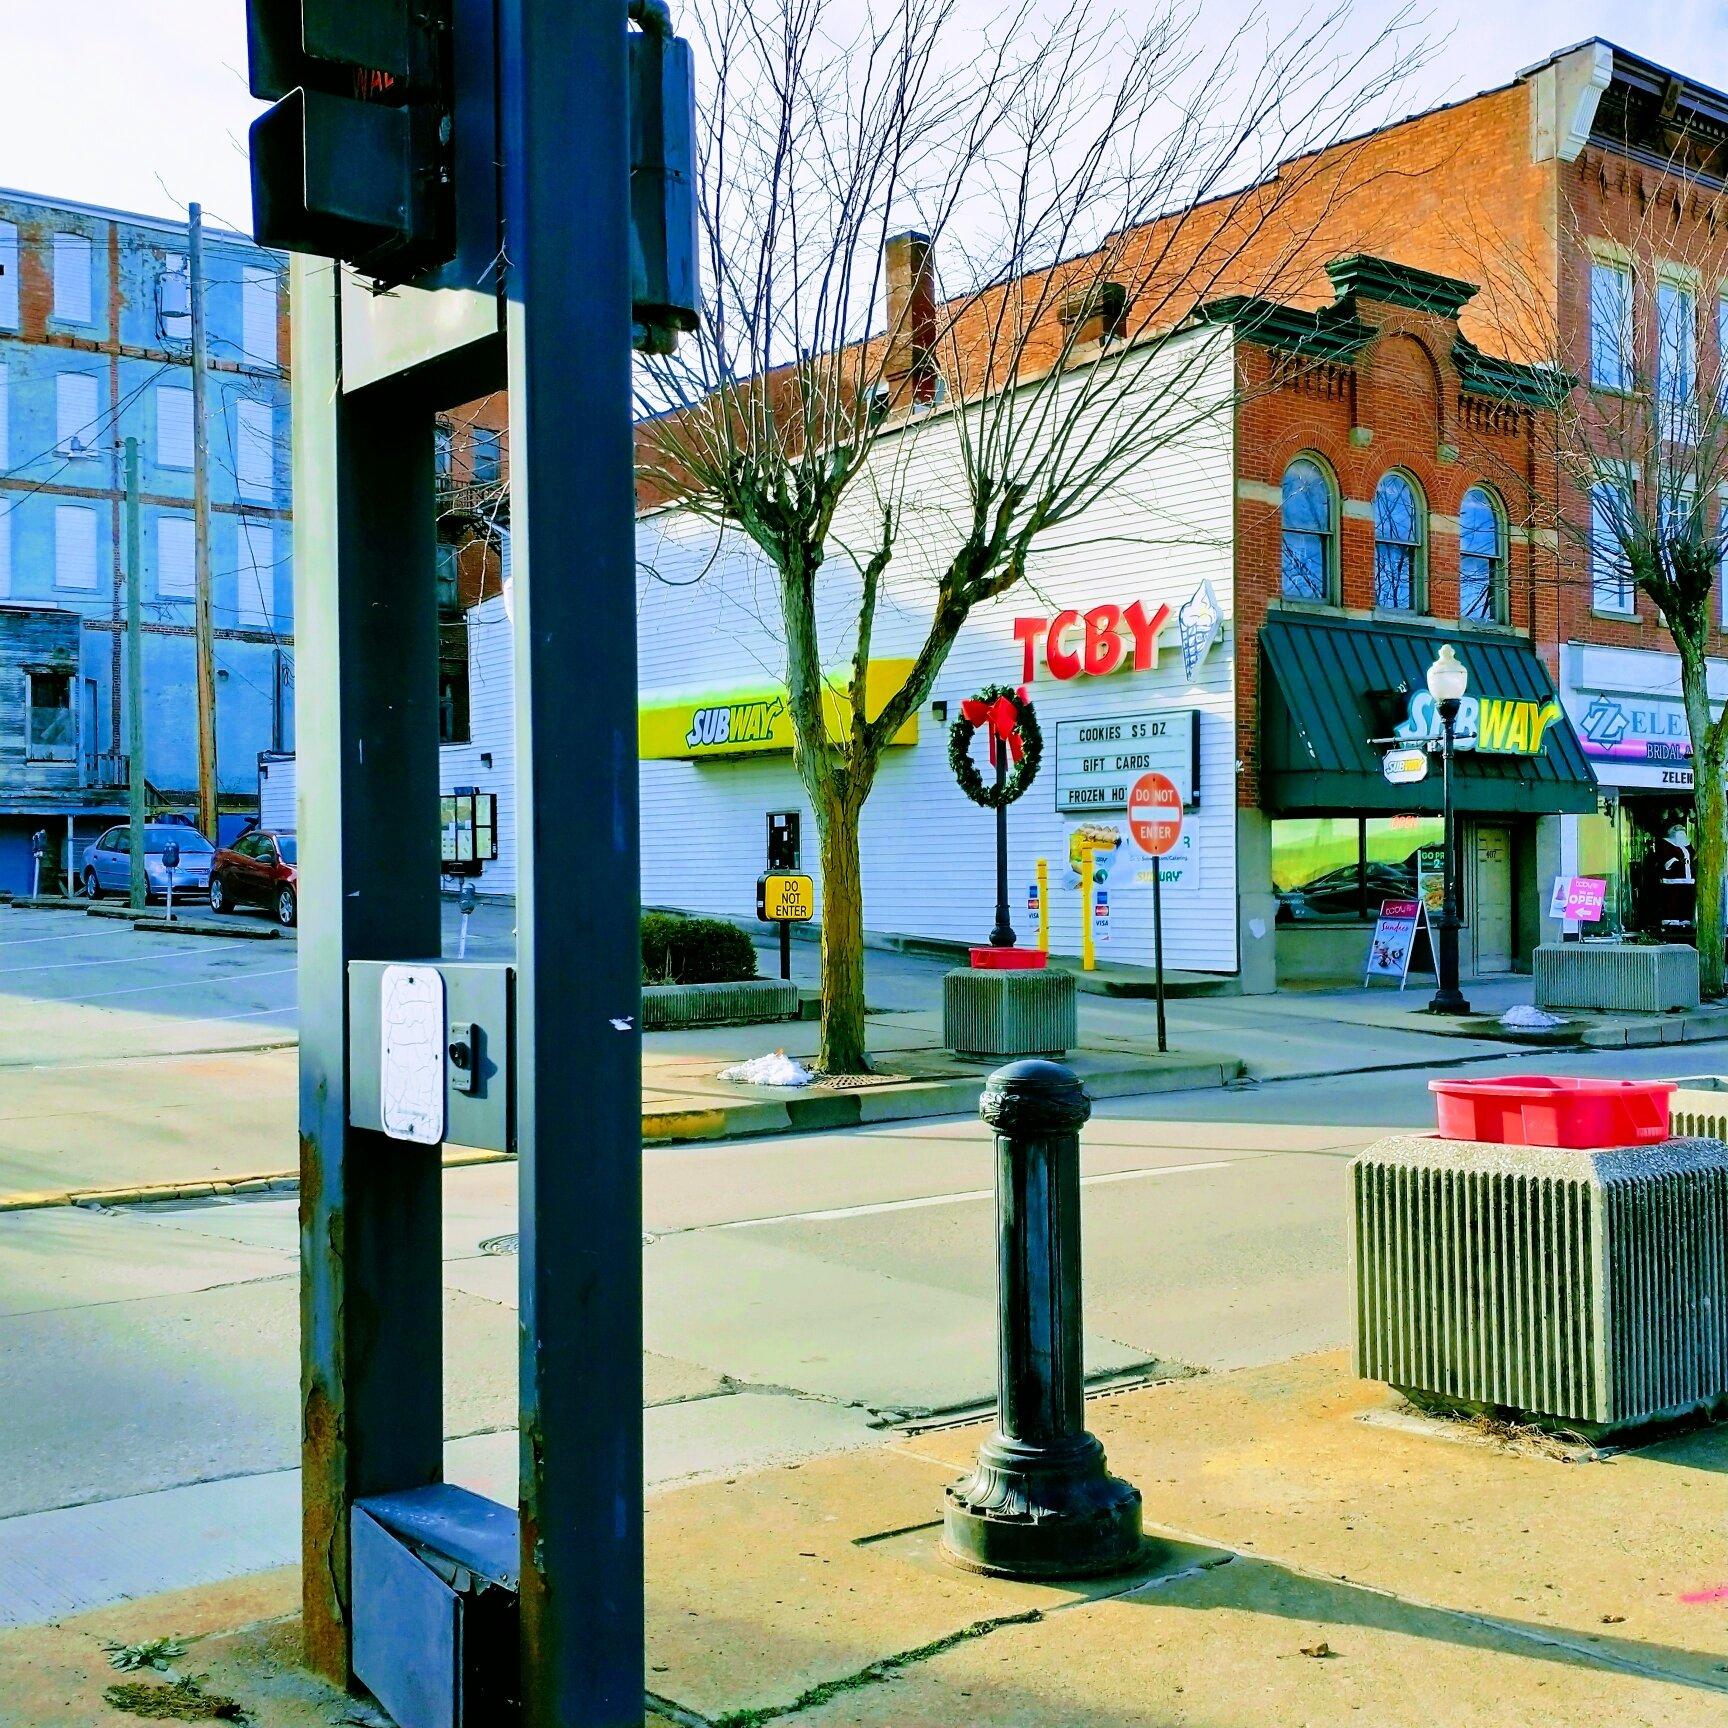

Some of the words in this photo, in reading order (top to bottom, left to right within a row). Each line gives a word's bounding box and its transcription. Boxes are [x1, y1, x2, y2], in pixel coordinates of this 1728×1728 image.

[1014, 600, 1171, 683] TCBY
[686, 697, 783, 749] SUBWAY
[1585, 701, 1689, 744] ZELE
[1080, 726, 1121, 741] COOKIES
[1152, 722, 1166, 735] DZ
[1647, 743, 1682, 759] BRIDAL
[1084, 758, 1105, 771] GIFT
[1116, 755, 1150, 769] CARDS
[1069, 789, 1104, 802] FROZEN
[1112, 788, 1127, 801] HO
[1136, 789, 1149, 801] DO
[1154, 789, 1173, 802] NOT
[1141, 826, 1171, 839] ENTER
[1435, 852, 1445, 860] PR
[785, 881, 798, 892] DO
[782, 893, 800, 904] NOT
[1569, 894, 1602, 906] OPEN
[776, 905, 806, 917] ENTER
